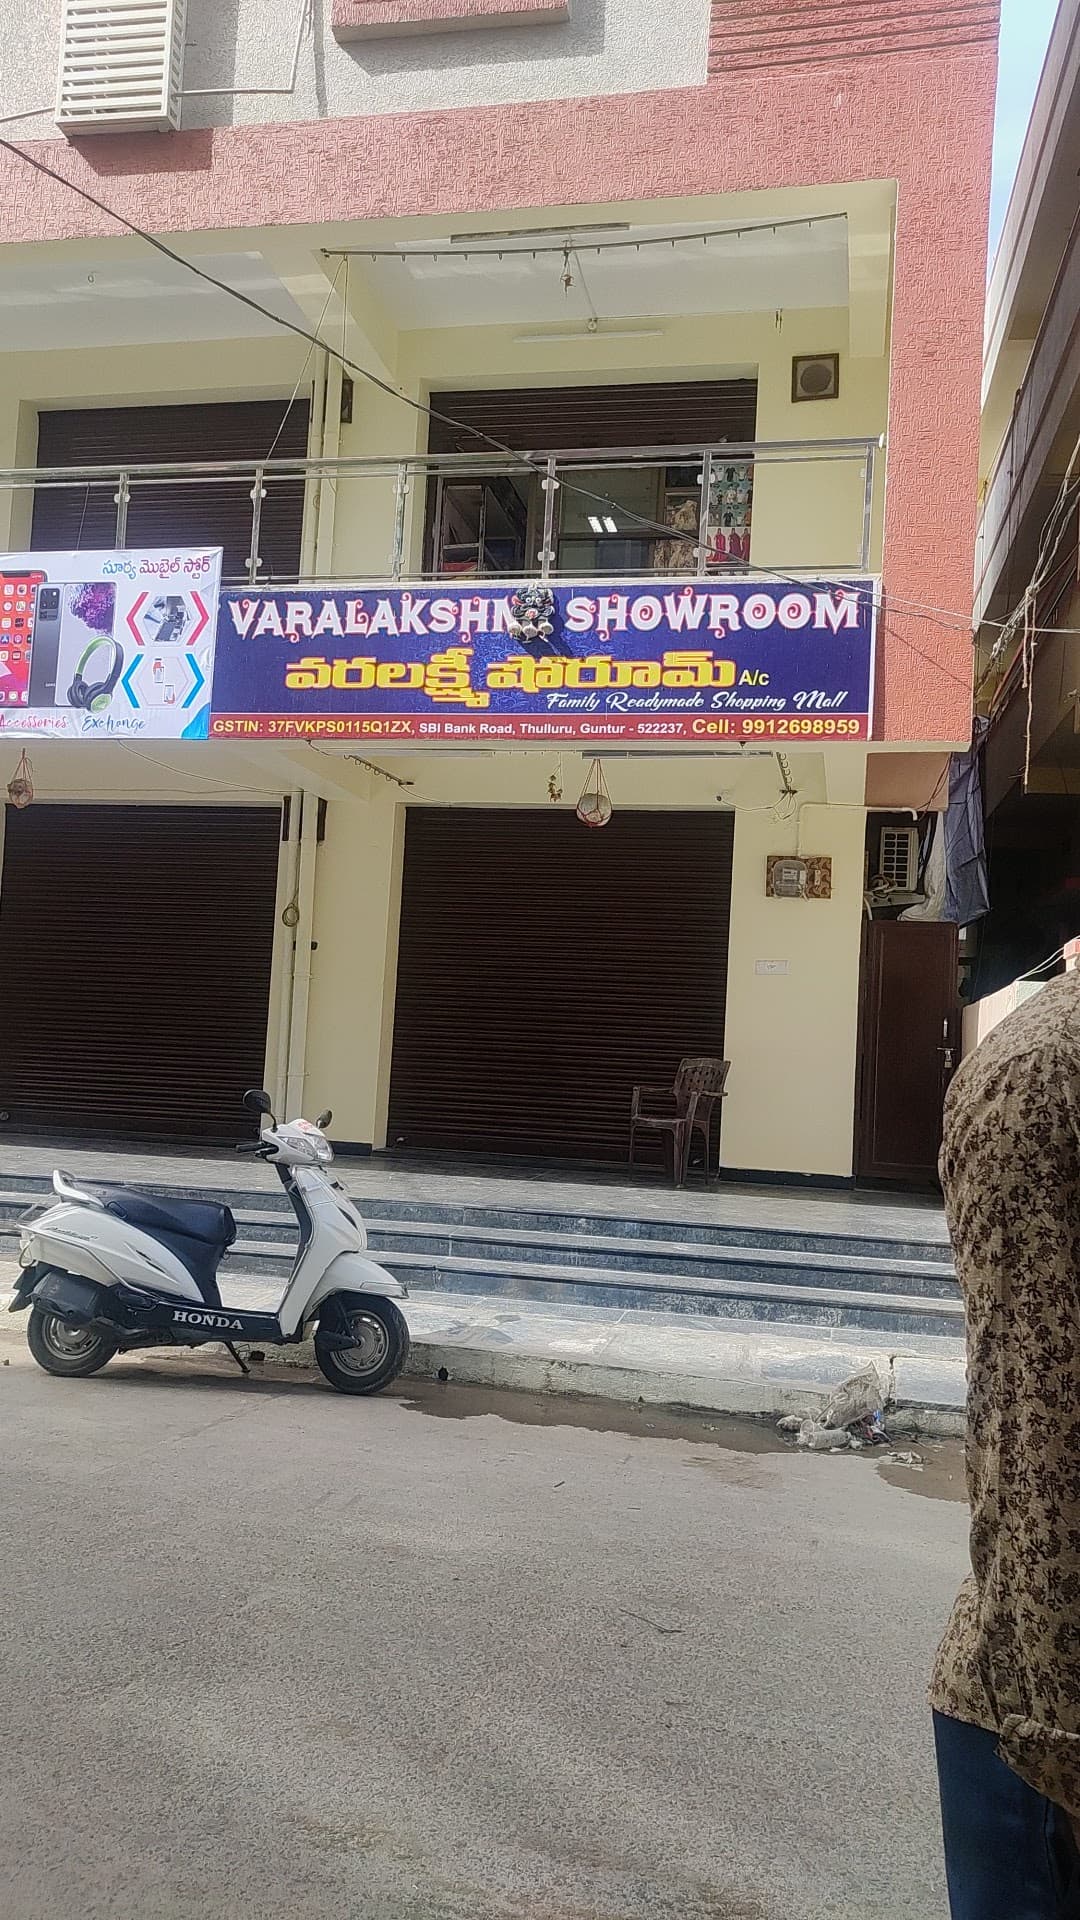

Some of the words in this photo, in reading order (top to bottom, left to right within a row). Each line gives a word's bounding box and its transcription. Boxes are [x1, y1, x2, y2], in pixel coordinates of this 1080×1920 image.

[102, 559, 137, 580] సూర్య
[139, 557, 182, 579] మొబైల్
[183, 555, 211, 580] స్టోర్
[565, 587, 860, 640] SHOWROOM
[738, 669, 770, 686] A/c
[546, 692, 600, 712] Family
[605, 692, 704, 712] Readymade
[710, 691, 786, 712] Shopping
[792, 690, 848, 710] Mall
[81, 714, 146, 733] Exchange
[213, 720, 263, 734] GSTIN:
[418, 722, 441, 733] SBI
[444, 722, 476, 734] Bank
[479, 723, 516, 736] Road,
[520, 723, 576, 736] Thulluru,
[579, 724, 625, 735] Guntur
[637, 724, 687, 737] 522237,
[691, 718, 735, 735] Cell:
[742, 718, 860, 735] 9912698959
[172, 1310, 244, 1330] HONDA
